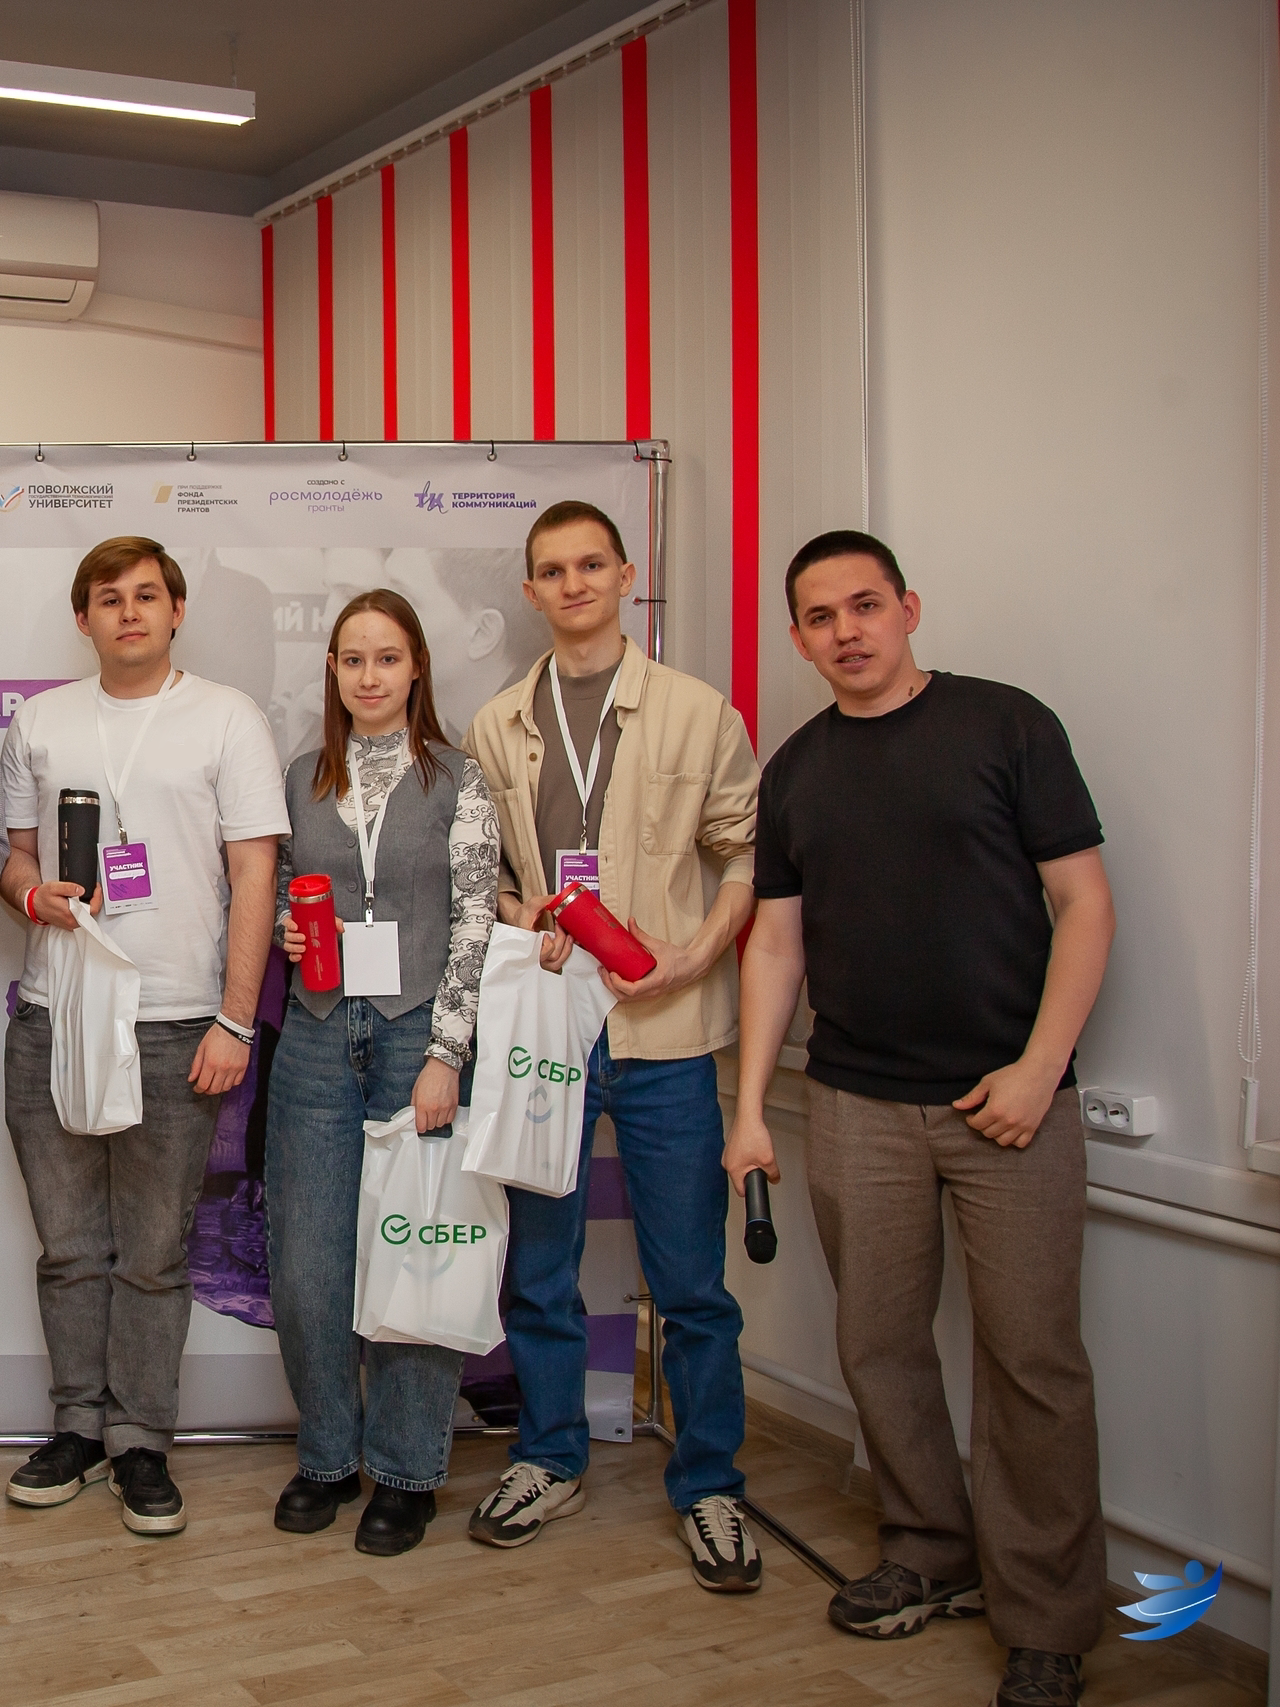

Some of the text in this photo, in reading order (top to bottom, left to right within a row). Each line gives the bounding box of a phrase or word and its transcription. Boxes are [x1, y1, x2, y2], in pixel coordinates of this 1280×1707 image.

[28, 483, 114, 494] ПОВОЛЖСКИЙ
[269, 488, 383, 506] росмолодёжь
[452, 492, 515, 500] ТЕРРИТОРИЯ
[29, 499, 113, 508] УНИВЕРСИТЕТ
[452, 500, 537, 509] КОММУНИКАЦИЙ
[308, 505, 345, 513] гранты
[418, 1224, 487, 1245] СБЕР
